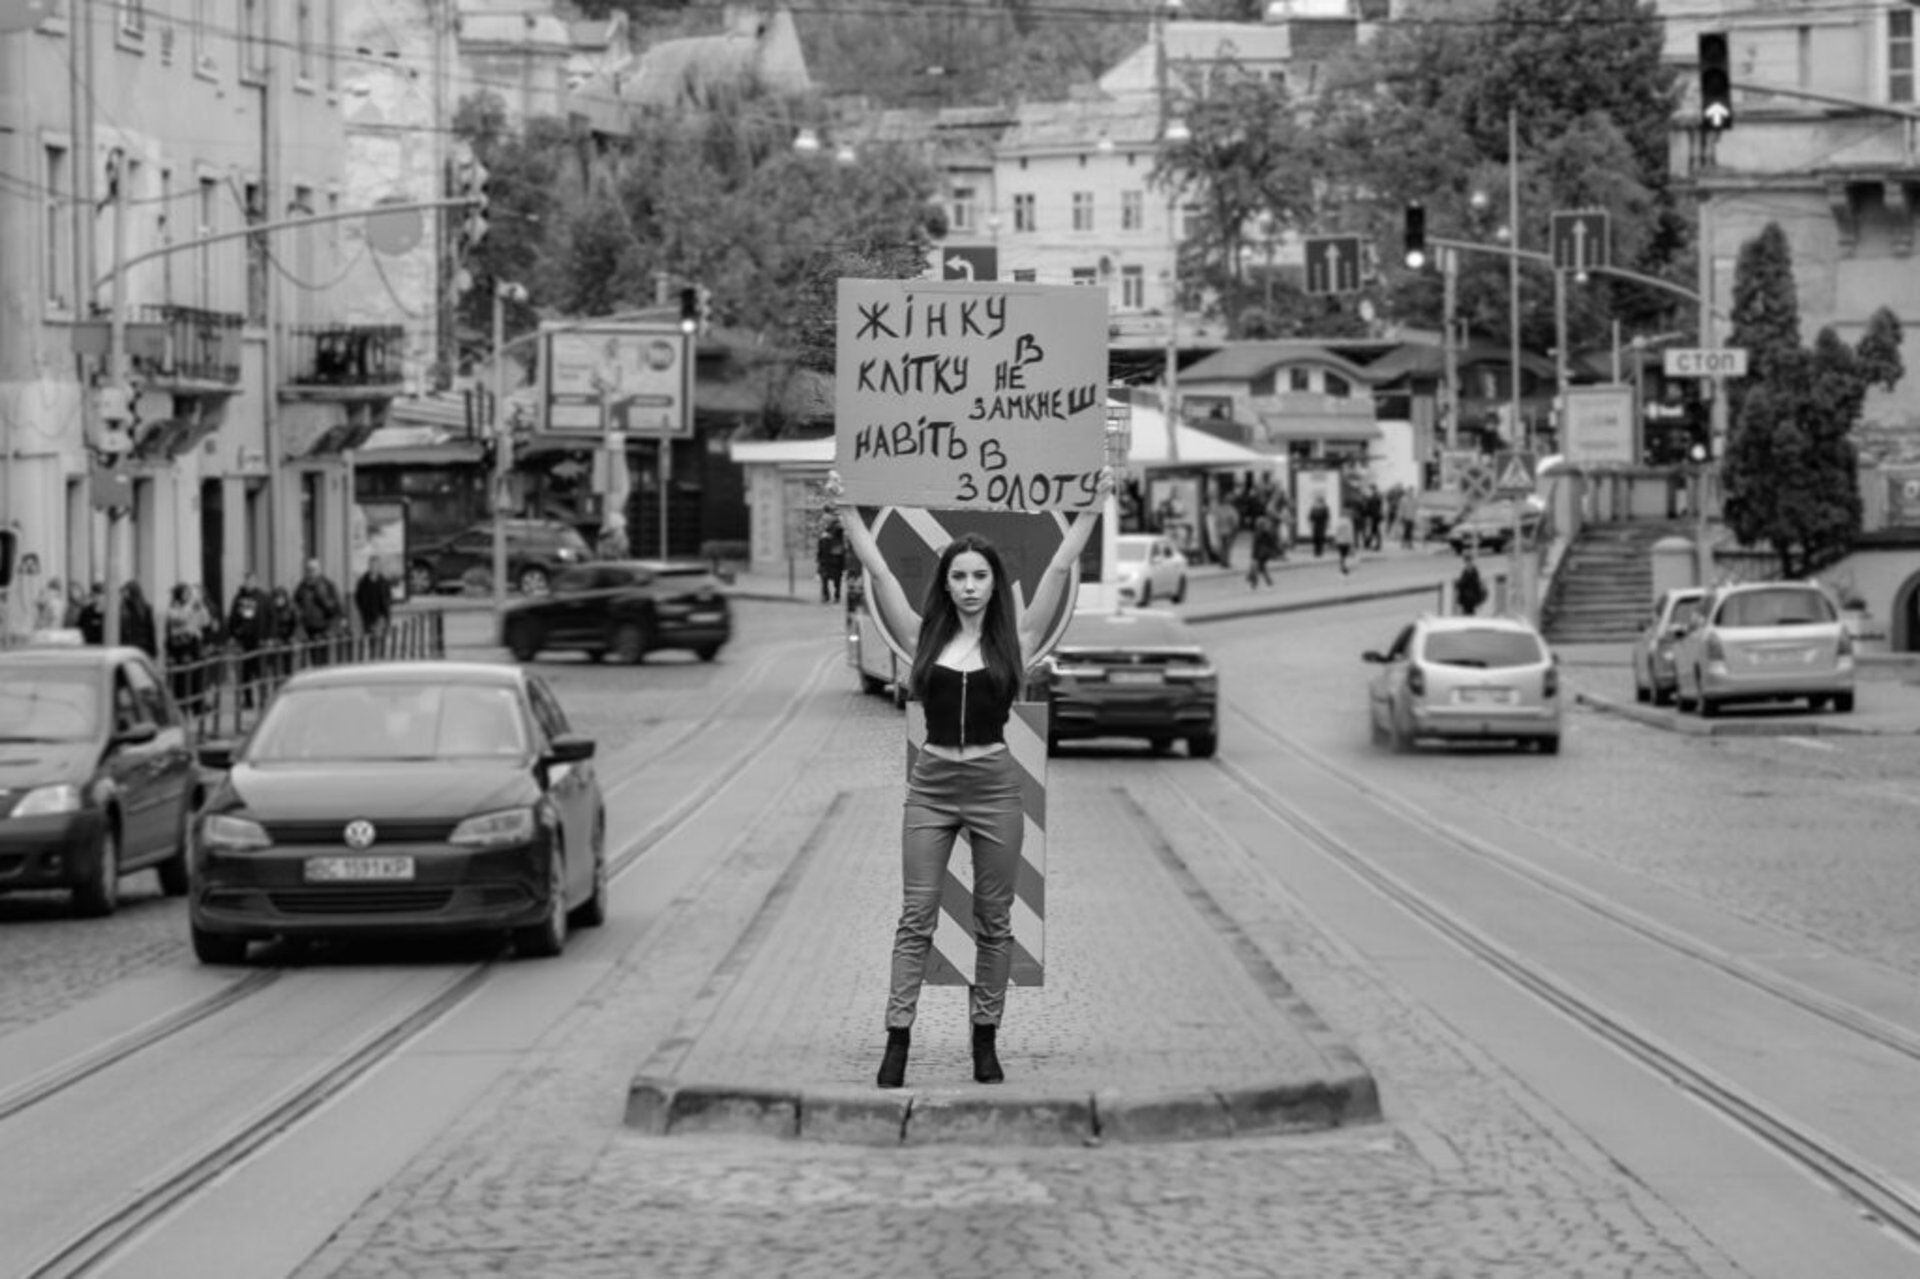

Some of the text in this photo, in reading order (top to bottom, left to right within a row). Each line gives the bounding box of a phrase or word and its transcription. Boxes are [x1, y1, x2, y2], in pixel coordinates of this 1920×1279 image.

[994, 361, 1026, 392] НЕ
[1676, 353, 1735, 371] СТОП
[968, 383, 1097, 420] ЗАМКНЕШ
[955, 470, 1103, 511] ЗОЛОТУ
